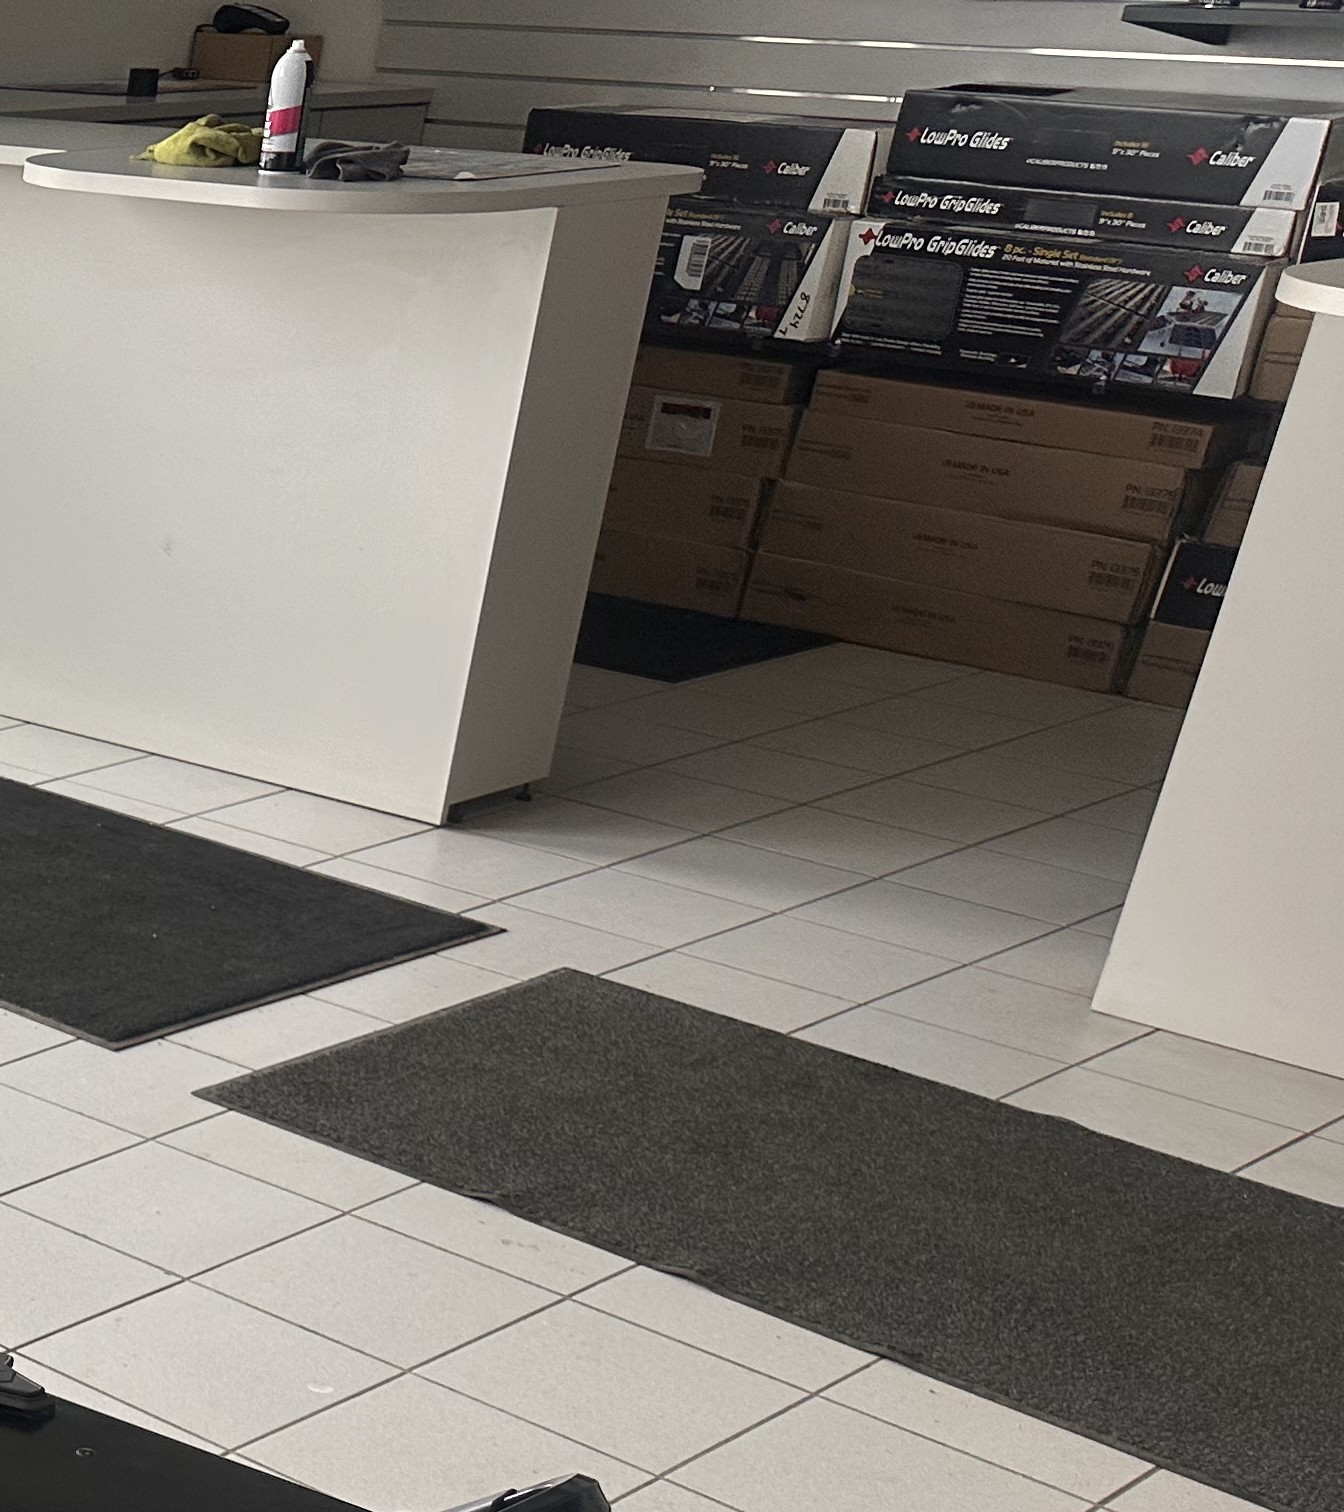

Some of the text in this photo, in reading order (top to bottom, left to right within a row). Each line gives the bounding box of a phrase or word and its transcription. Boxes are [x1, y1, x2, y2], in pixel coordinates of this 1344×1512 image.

[920, 126, 1011, 150] LowPro Glides
[1209, 150, 1256, 168] Caliber
[777, 162, 810, 176] Caliber
[894, 190, 1002, 215] LowPro GripGlides
[783, 221, 818, 236] Caliber
[1185, 220, 1229, 236] Caliber
[875, 230, 998, 259] LowPro GripGlides
[1204, 268, 1248, 286] Caliber
[1196, 577, 1227, 598] Low
